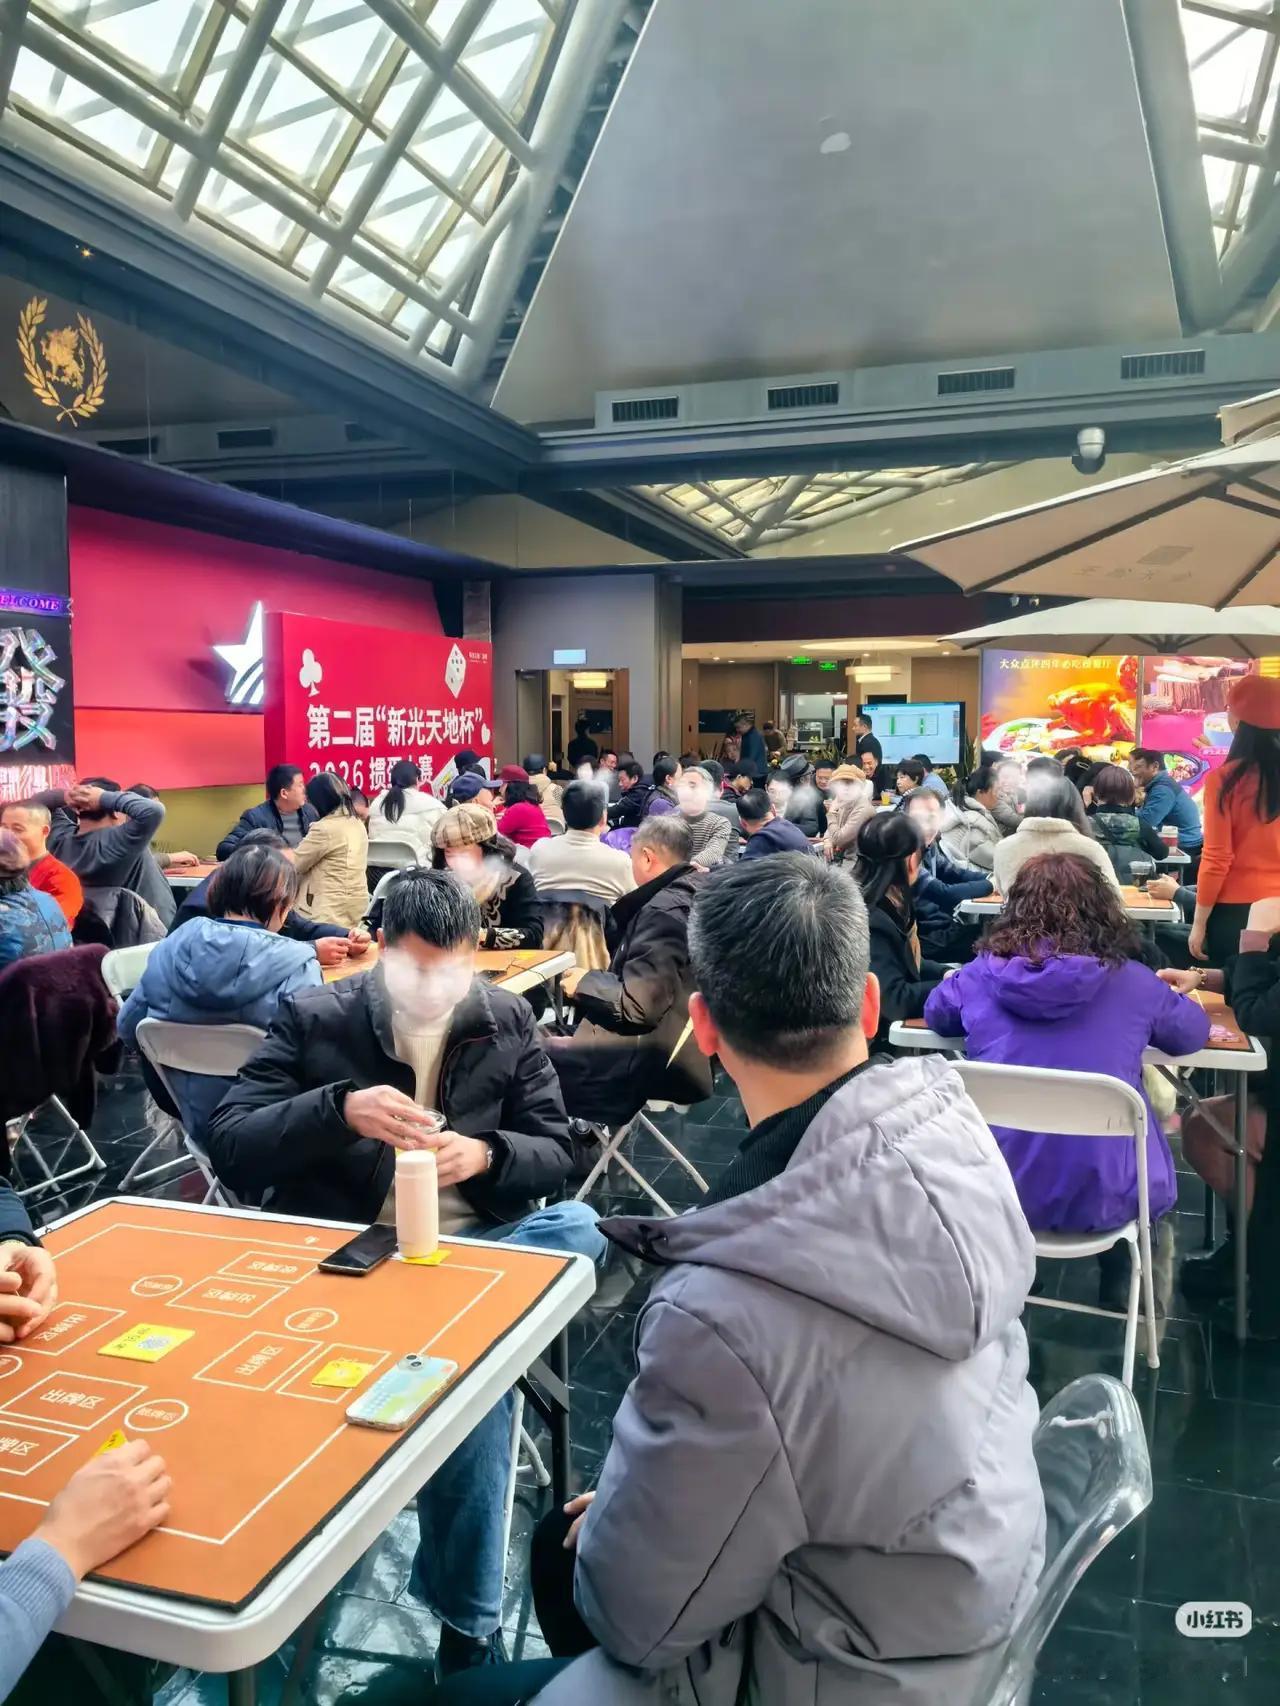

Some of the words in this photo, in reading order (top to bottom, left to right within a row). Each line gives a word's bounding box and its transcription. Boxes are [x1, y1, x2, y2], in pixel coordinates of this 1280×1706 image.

[0, 594, 60, 610] ELCOME
[306, 703, 483, 749] 第二届“新光天地杯”
